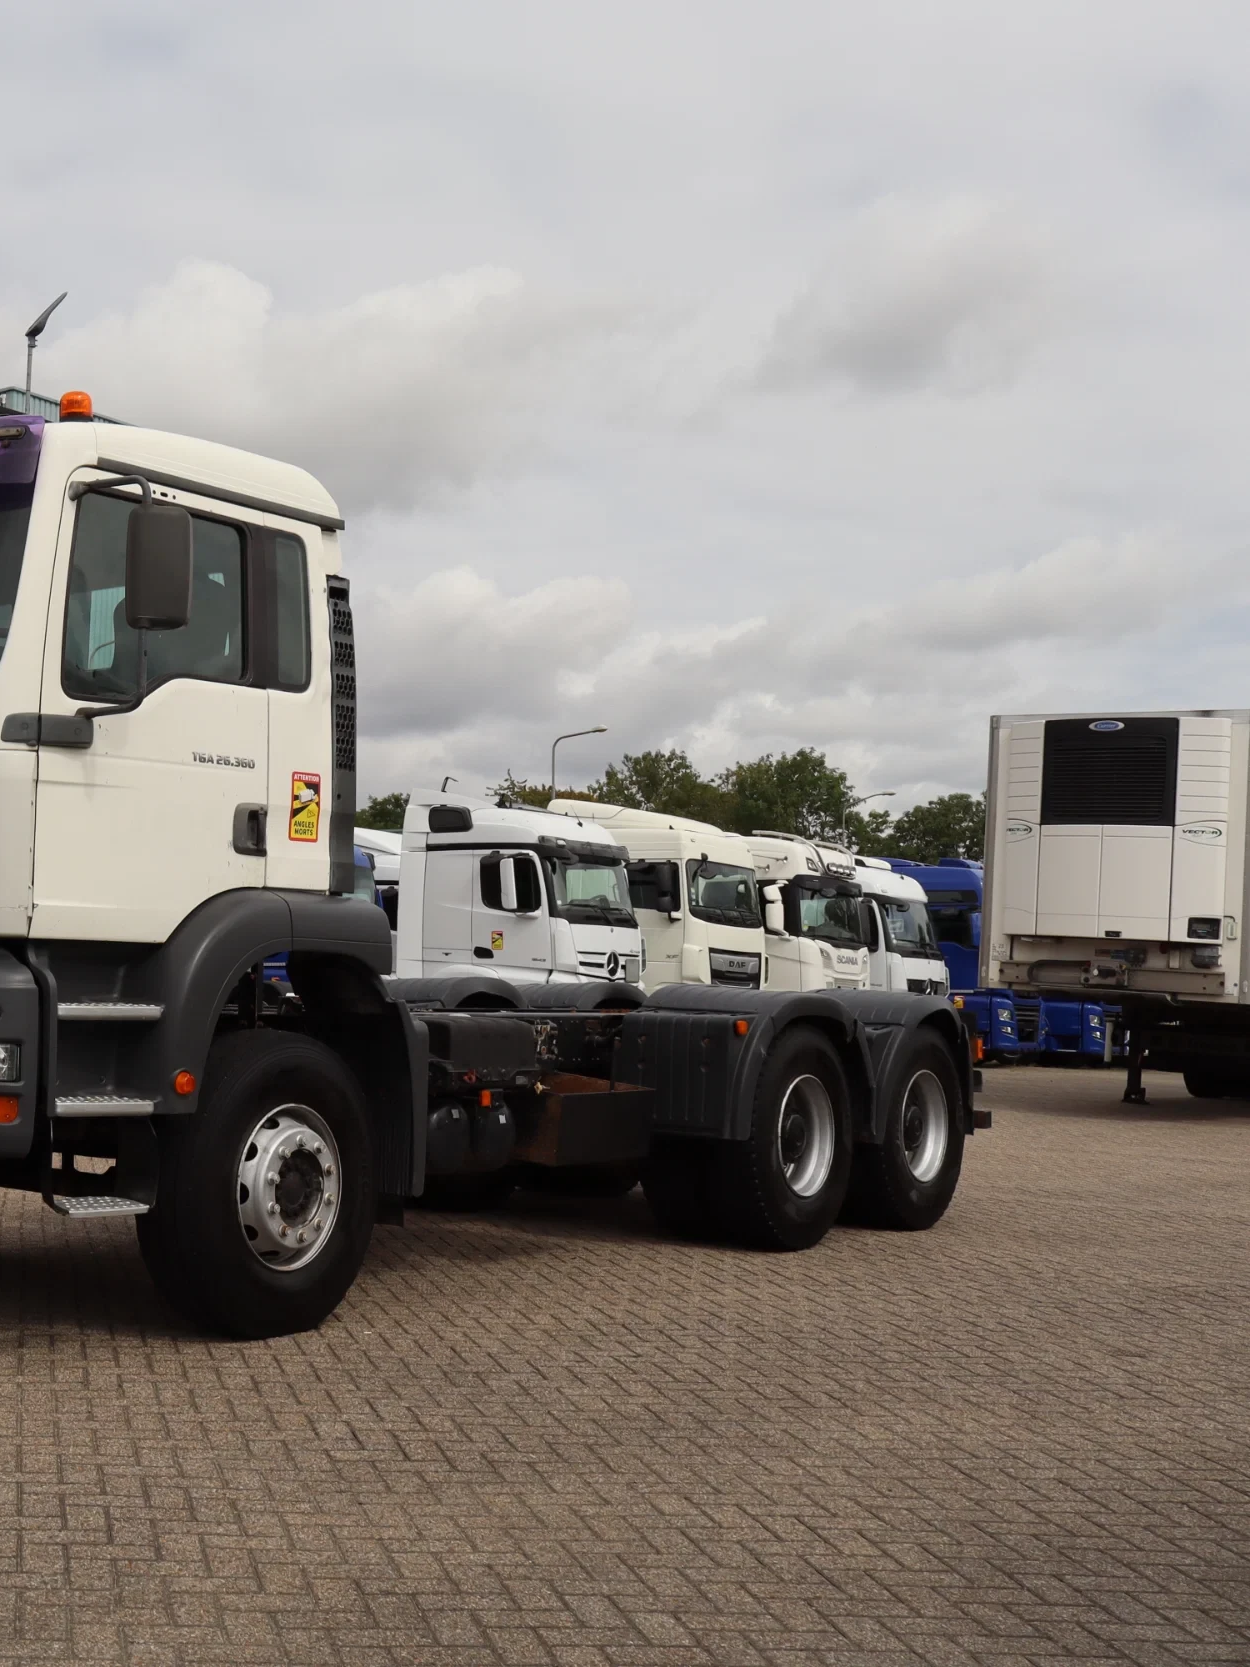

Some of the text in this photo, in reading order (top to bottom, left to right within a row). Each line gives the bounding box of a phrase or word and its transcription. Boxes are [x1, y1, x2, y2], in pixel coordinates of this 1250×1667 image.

[192, 751, 255, 769] TGA 26.360
[293, 773, 319, 783] ATTENTION
[293, 820, 315, 829] ANGLES
[294, 828, 314, 836] MORTS
[728, 960, 746, 969] DAF
[836, 954, 859, 966] SCANIA
